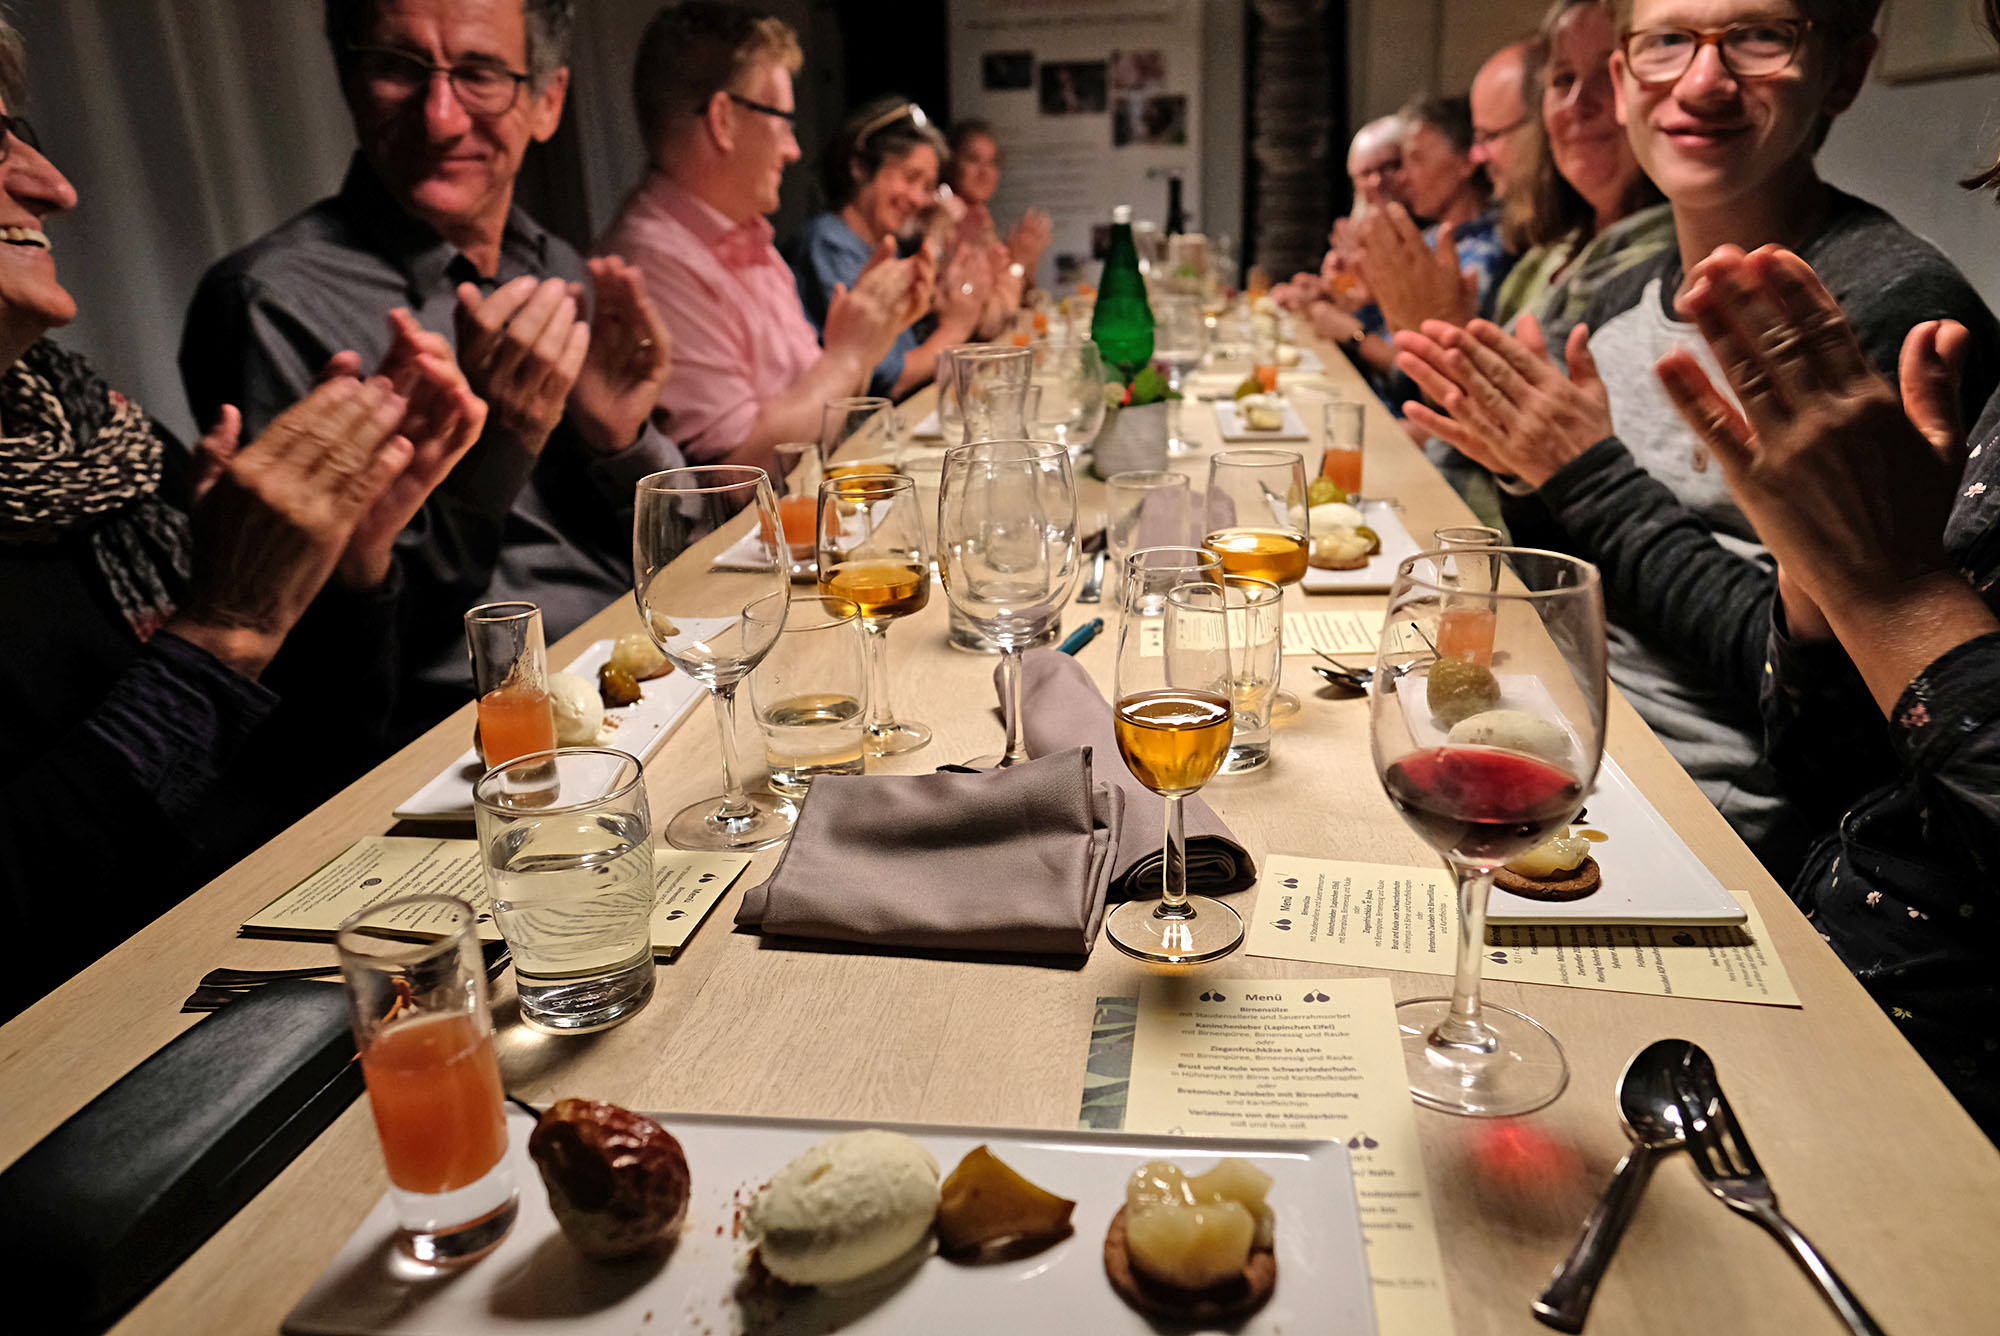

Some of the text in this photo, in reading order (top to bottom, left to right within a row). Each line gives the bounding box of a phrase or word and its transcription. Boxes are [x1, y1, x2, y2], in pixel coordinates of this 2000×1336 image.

[1279, 895, 1292, 911] Menü
[1352, 905, 1360, 914] oder
[1427, 930, 1436, 952] Bretonische
